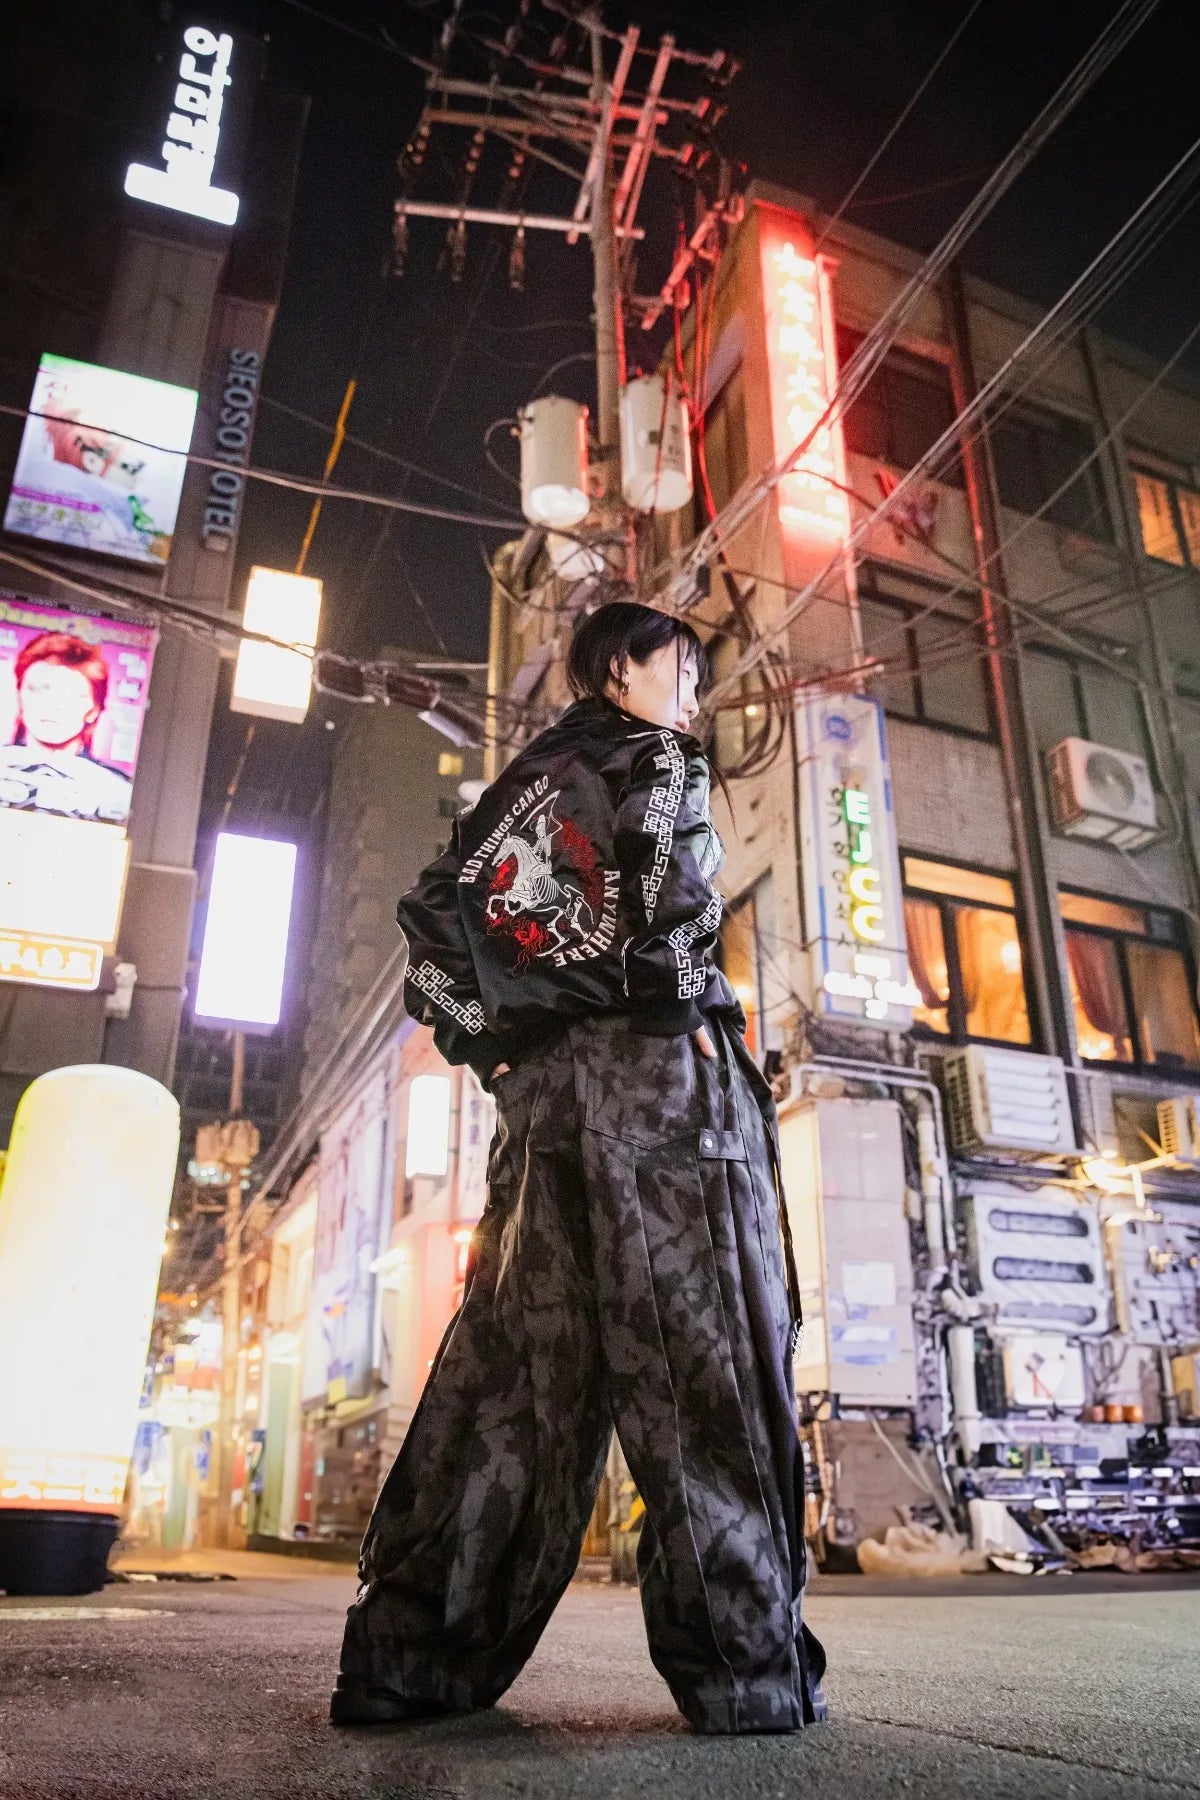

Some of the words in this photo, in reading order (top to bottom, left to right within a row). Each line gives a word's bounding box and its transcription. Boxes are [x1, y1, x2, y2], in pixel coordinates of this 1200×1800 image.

[458, 859, 484, 884] BAD
[473, 813, 515, 859] THINGS
[512, 787, 536, 816] CAN
[534, 775, 549, 796] GO
[552, 870, 621, 968] ANYWHERE
